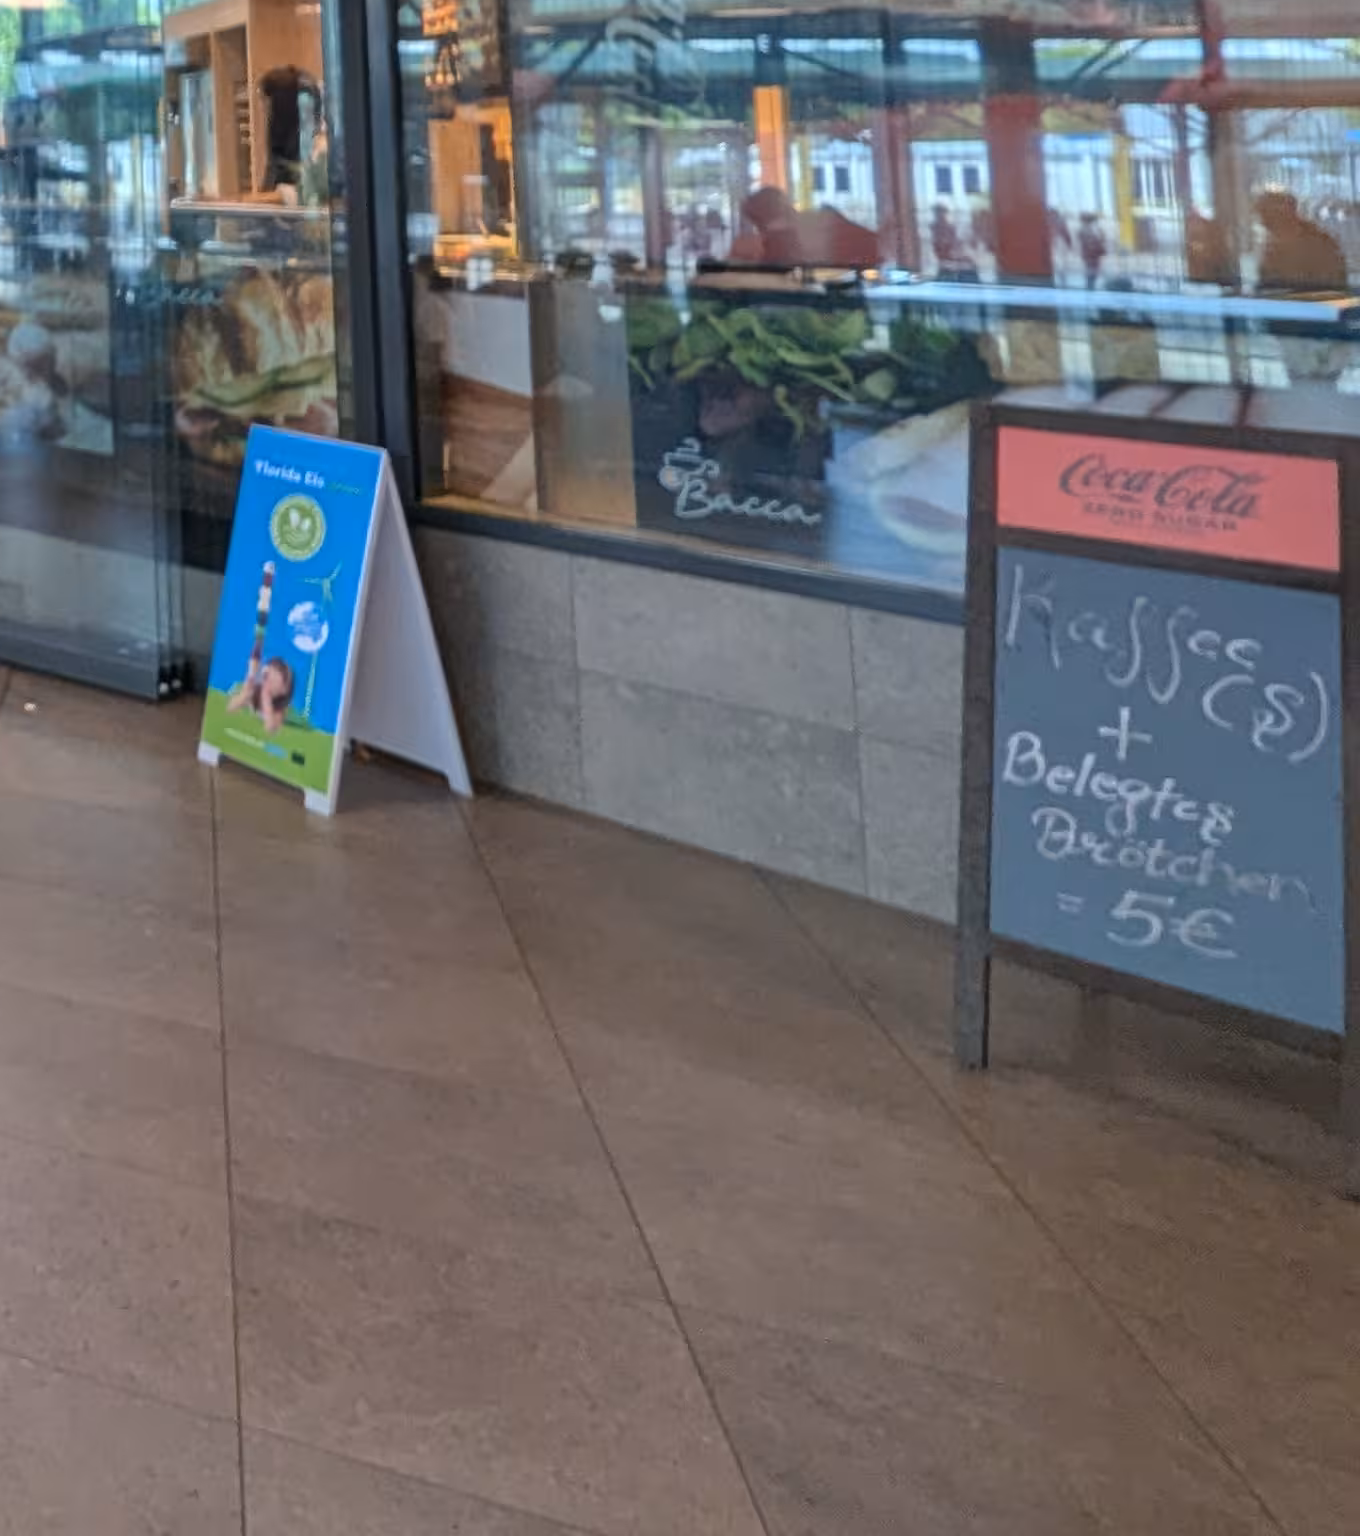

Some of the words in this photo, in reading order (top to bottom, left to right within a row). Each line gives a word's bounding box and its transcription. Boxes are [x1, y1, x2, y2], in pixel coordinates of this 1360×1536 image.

[254, 459, 301, 484] Florida
[675, 478, 822, 528] Bacca
[1059, 452, 1267, 520] Coca-Cola
[1031, 806, 1318, 914] Brötchen
[1106, 889, 1238, 959] 5€
